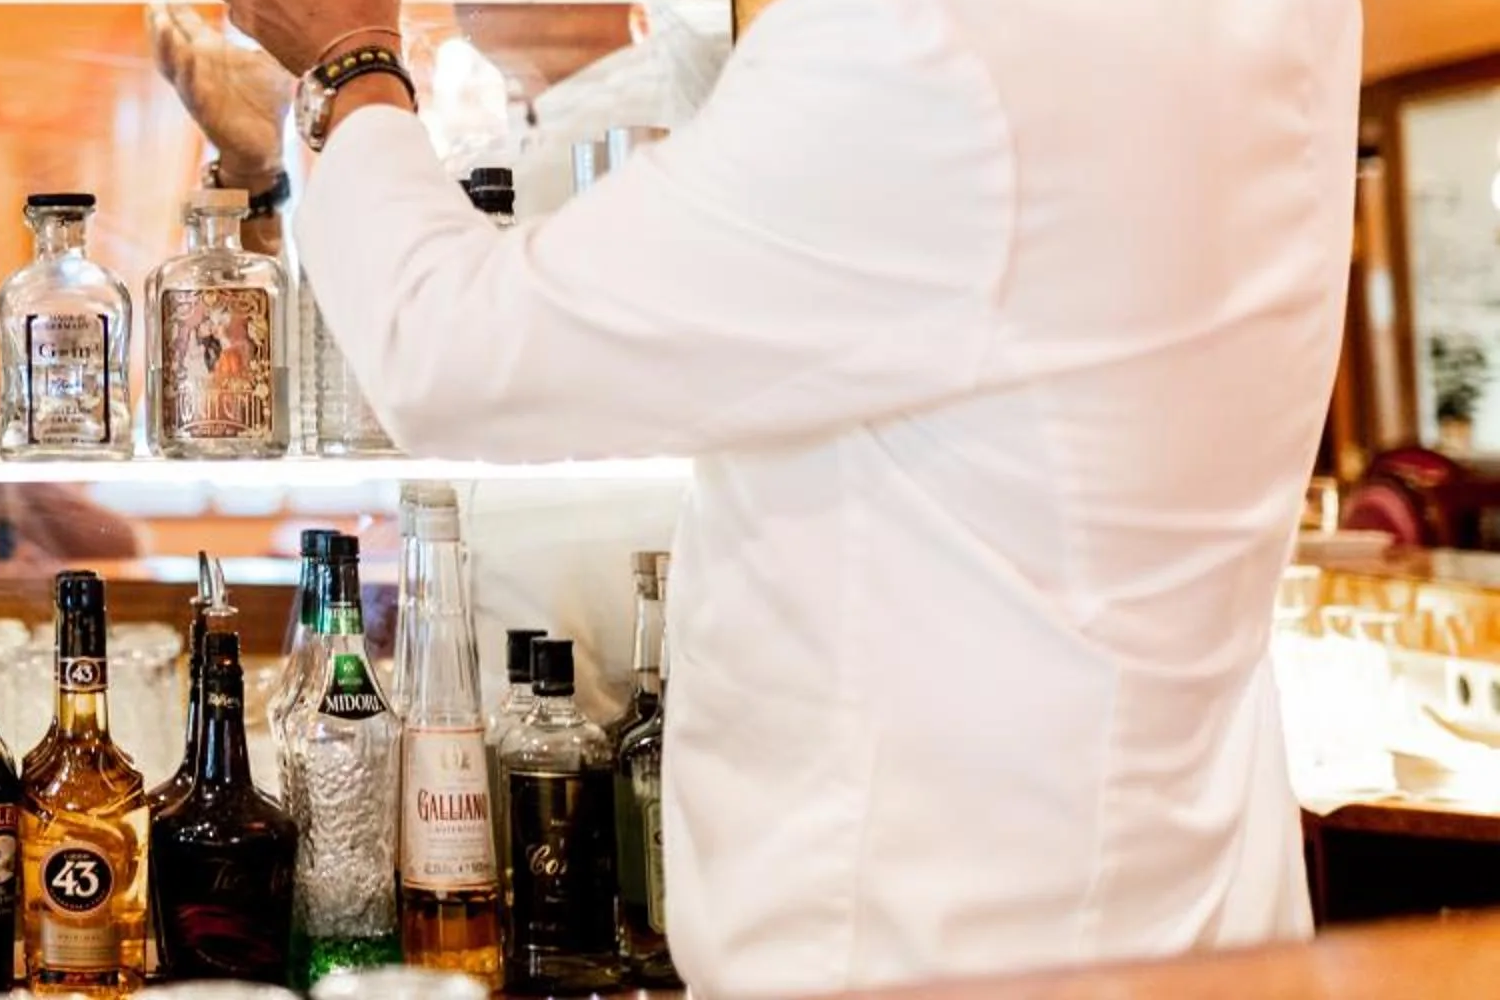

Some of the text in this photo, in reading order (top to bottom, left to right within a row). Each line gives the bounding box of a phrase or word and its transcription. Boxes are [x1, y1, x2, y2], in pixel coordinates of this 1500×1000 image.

[71, 666, 94, 683] 43
[325, 693, 384, 714] MIDORI
[51, 860, 100, 898] 43
